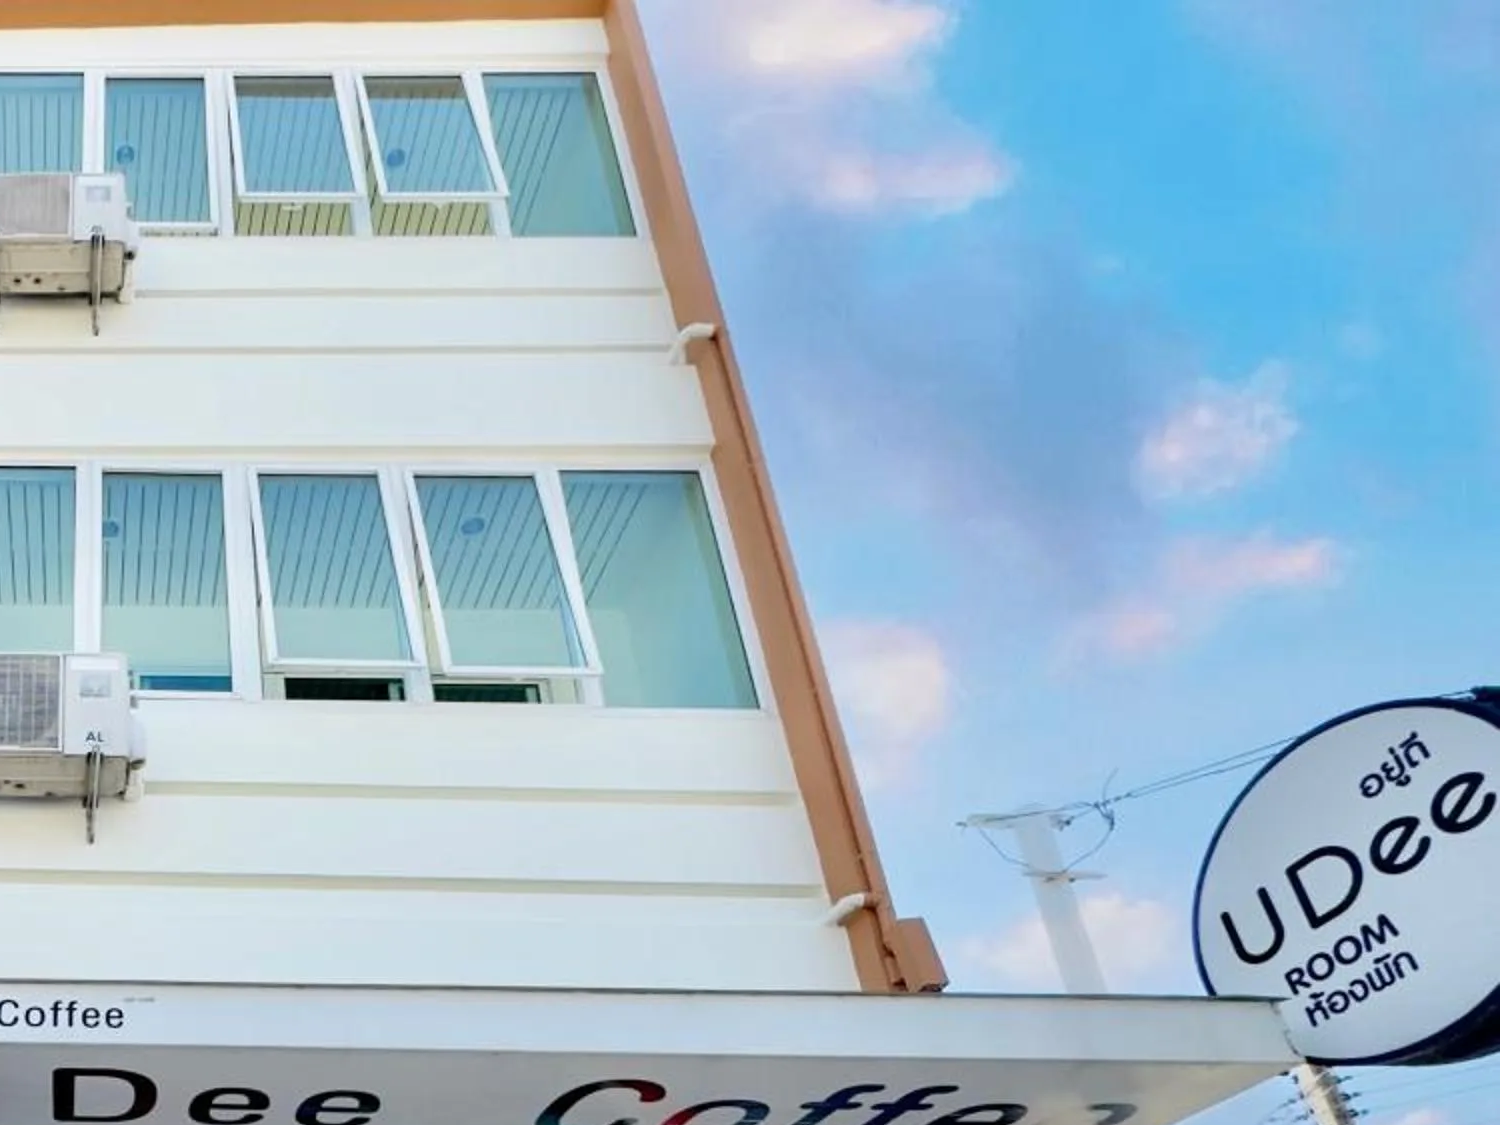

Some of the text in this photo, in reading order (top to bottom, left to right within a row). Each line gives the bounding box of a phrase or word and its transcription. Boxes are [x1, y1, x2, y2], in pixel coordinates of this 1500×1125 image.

[1284, 913, 1400, 996] ROOM
[1305, 950, 1420, 1028] ห้องพัก
